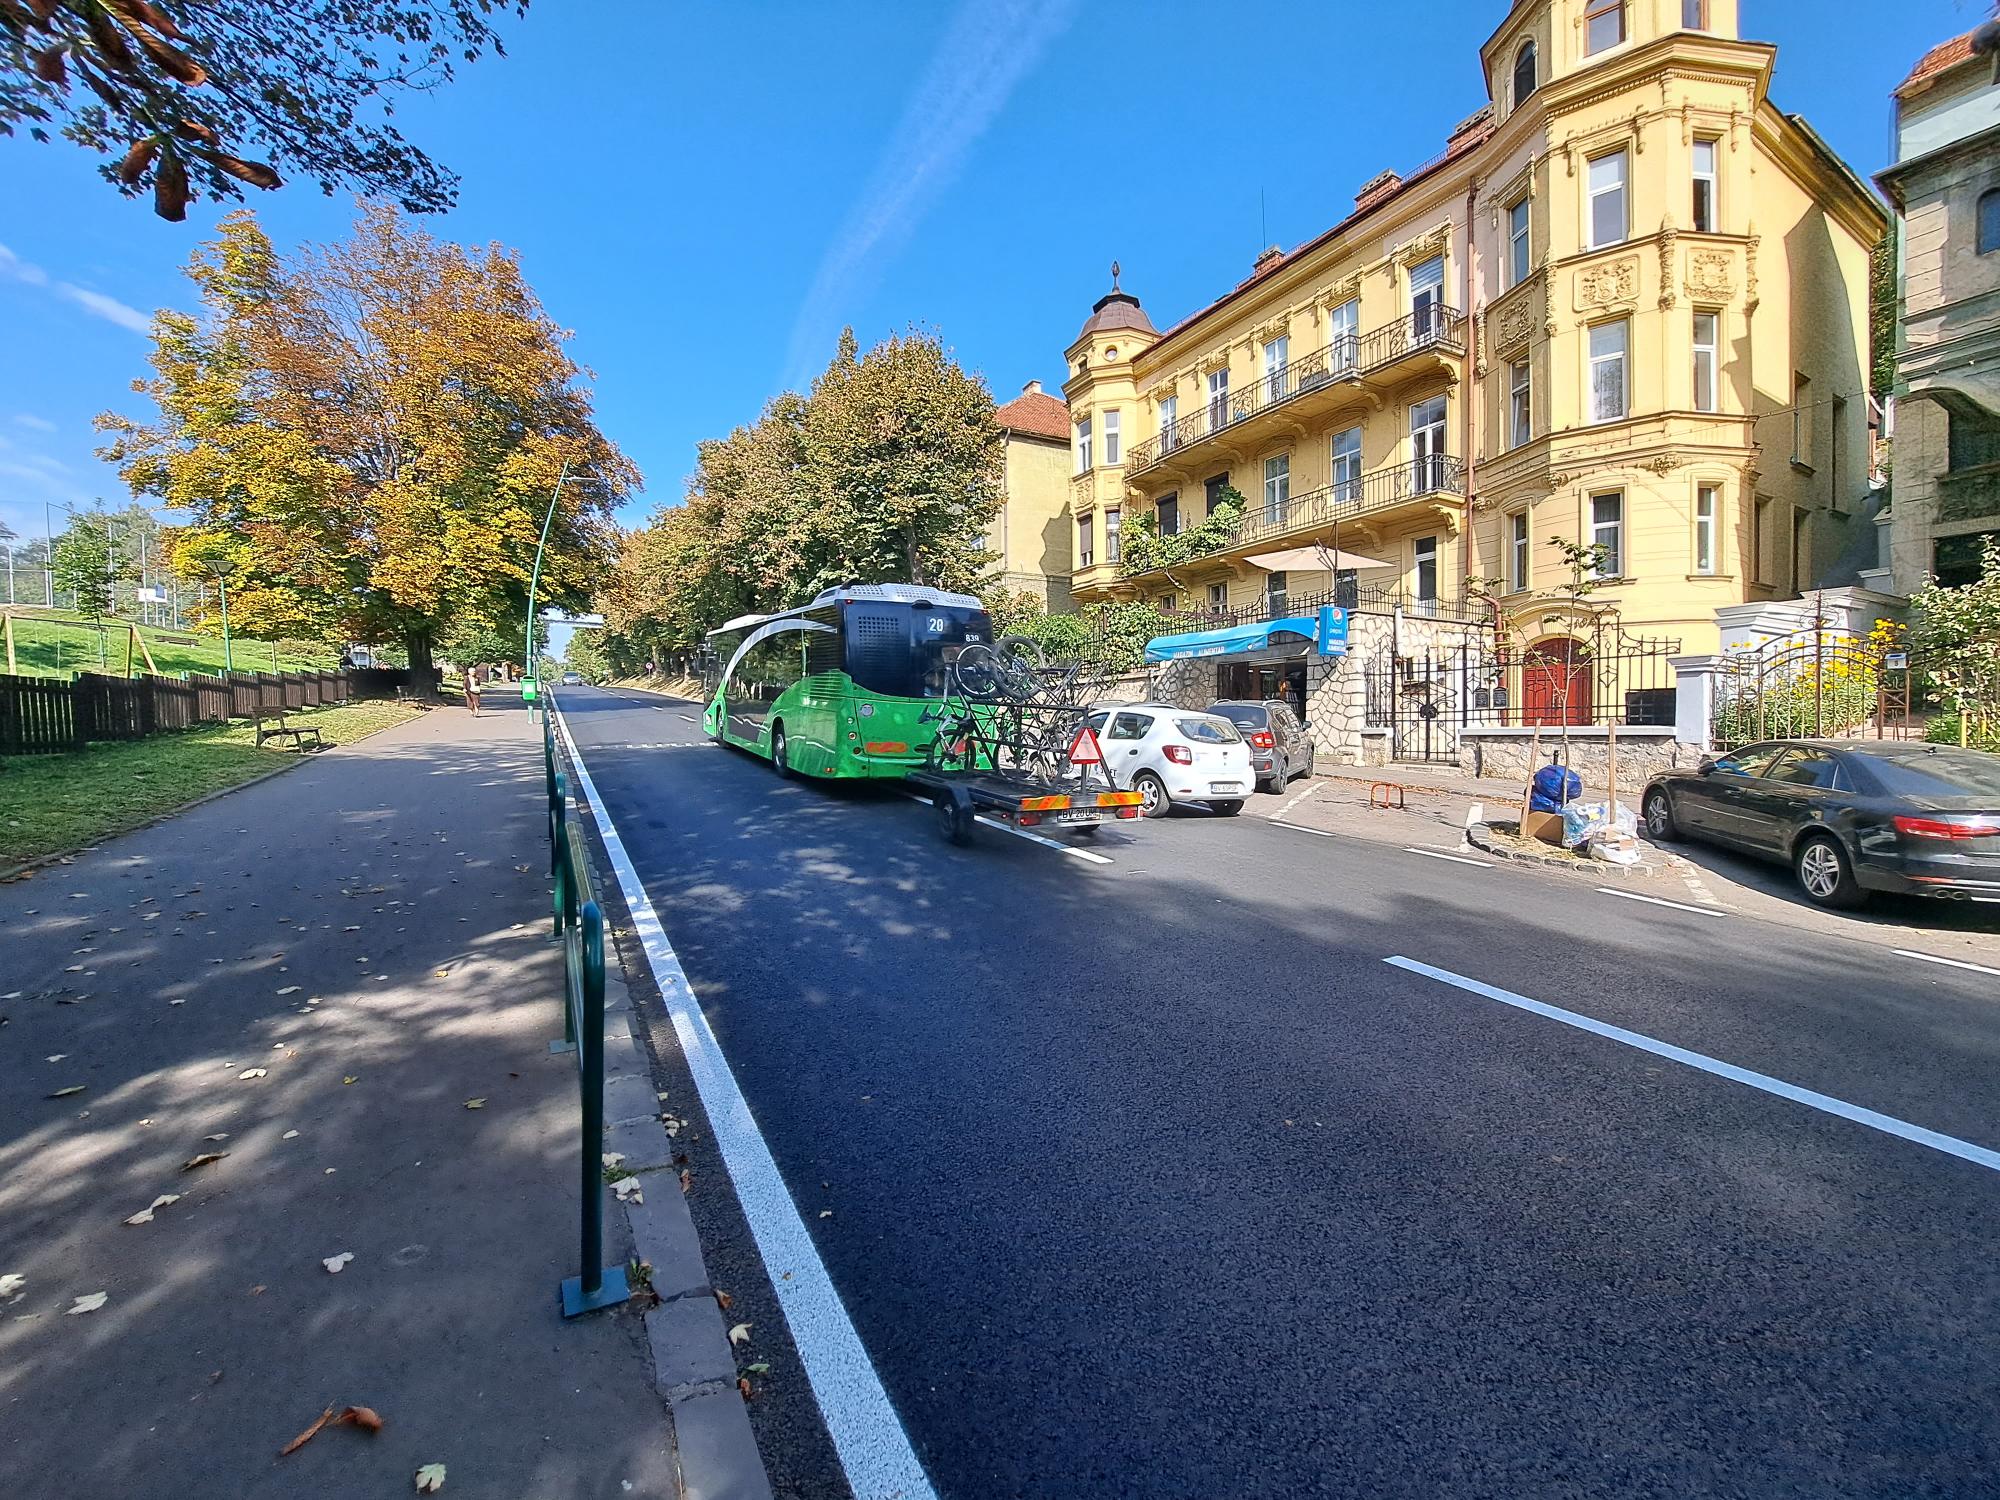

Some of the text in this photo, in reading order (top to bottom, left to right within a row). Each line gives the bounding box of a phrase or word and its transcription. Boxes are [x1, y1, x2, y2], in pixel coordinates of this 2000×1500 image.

[929, 618, 944, 632] 20
[965, 634, 980, 642] 839
[1198, 646, 1225, 657] ALIMENTAR
